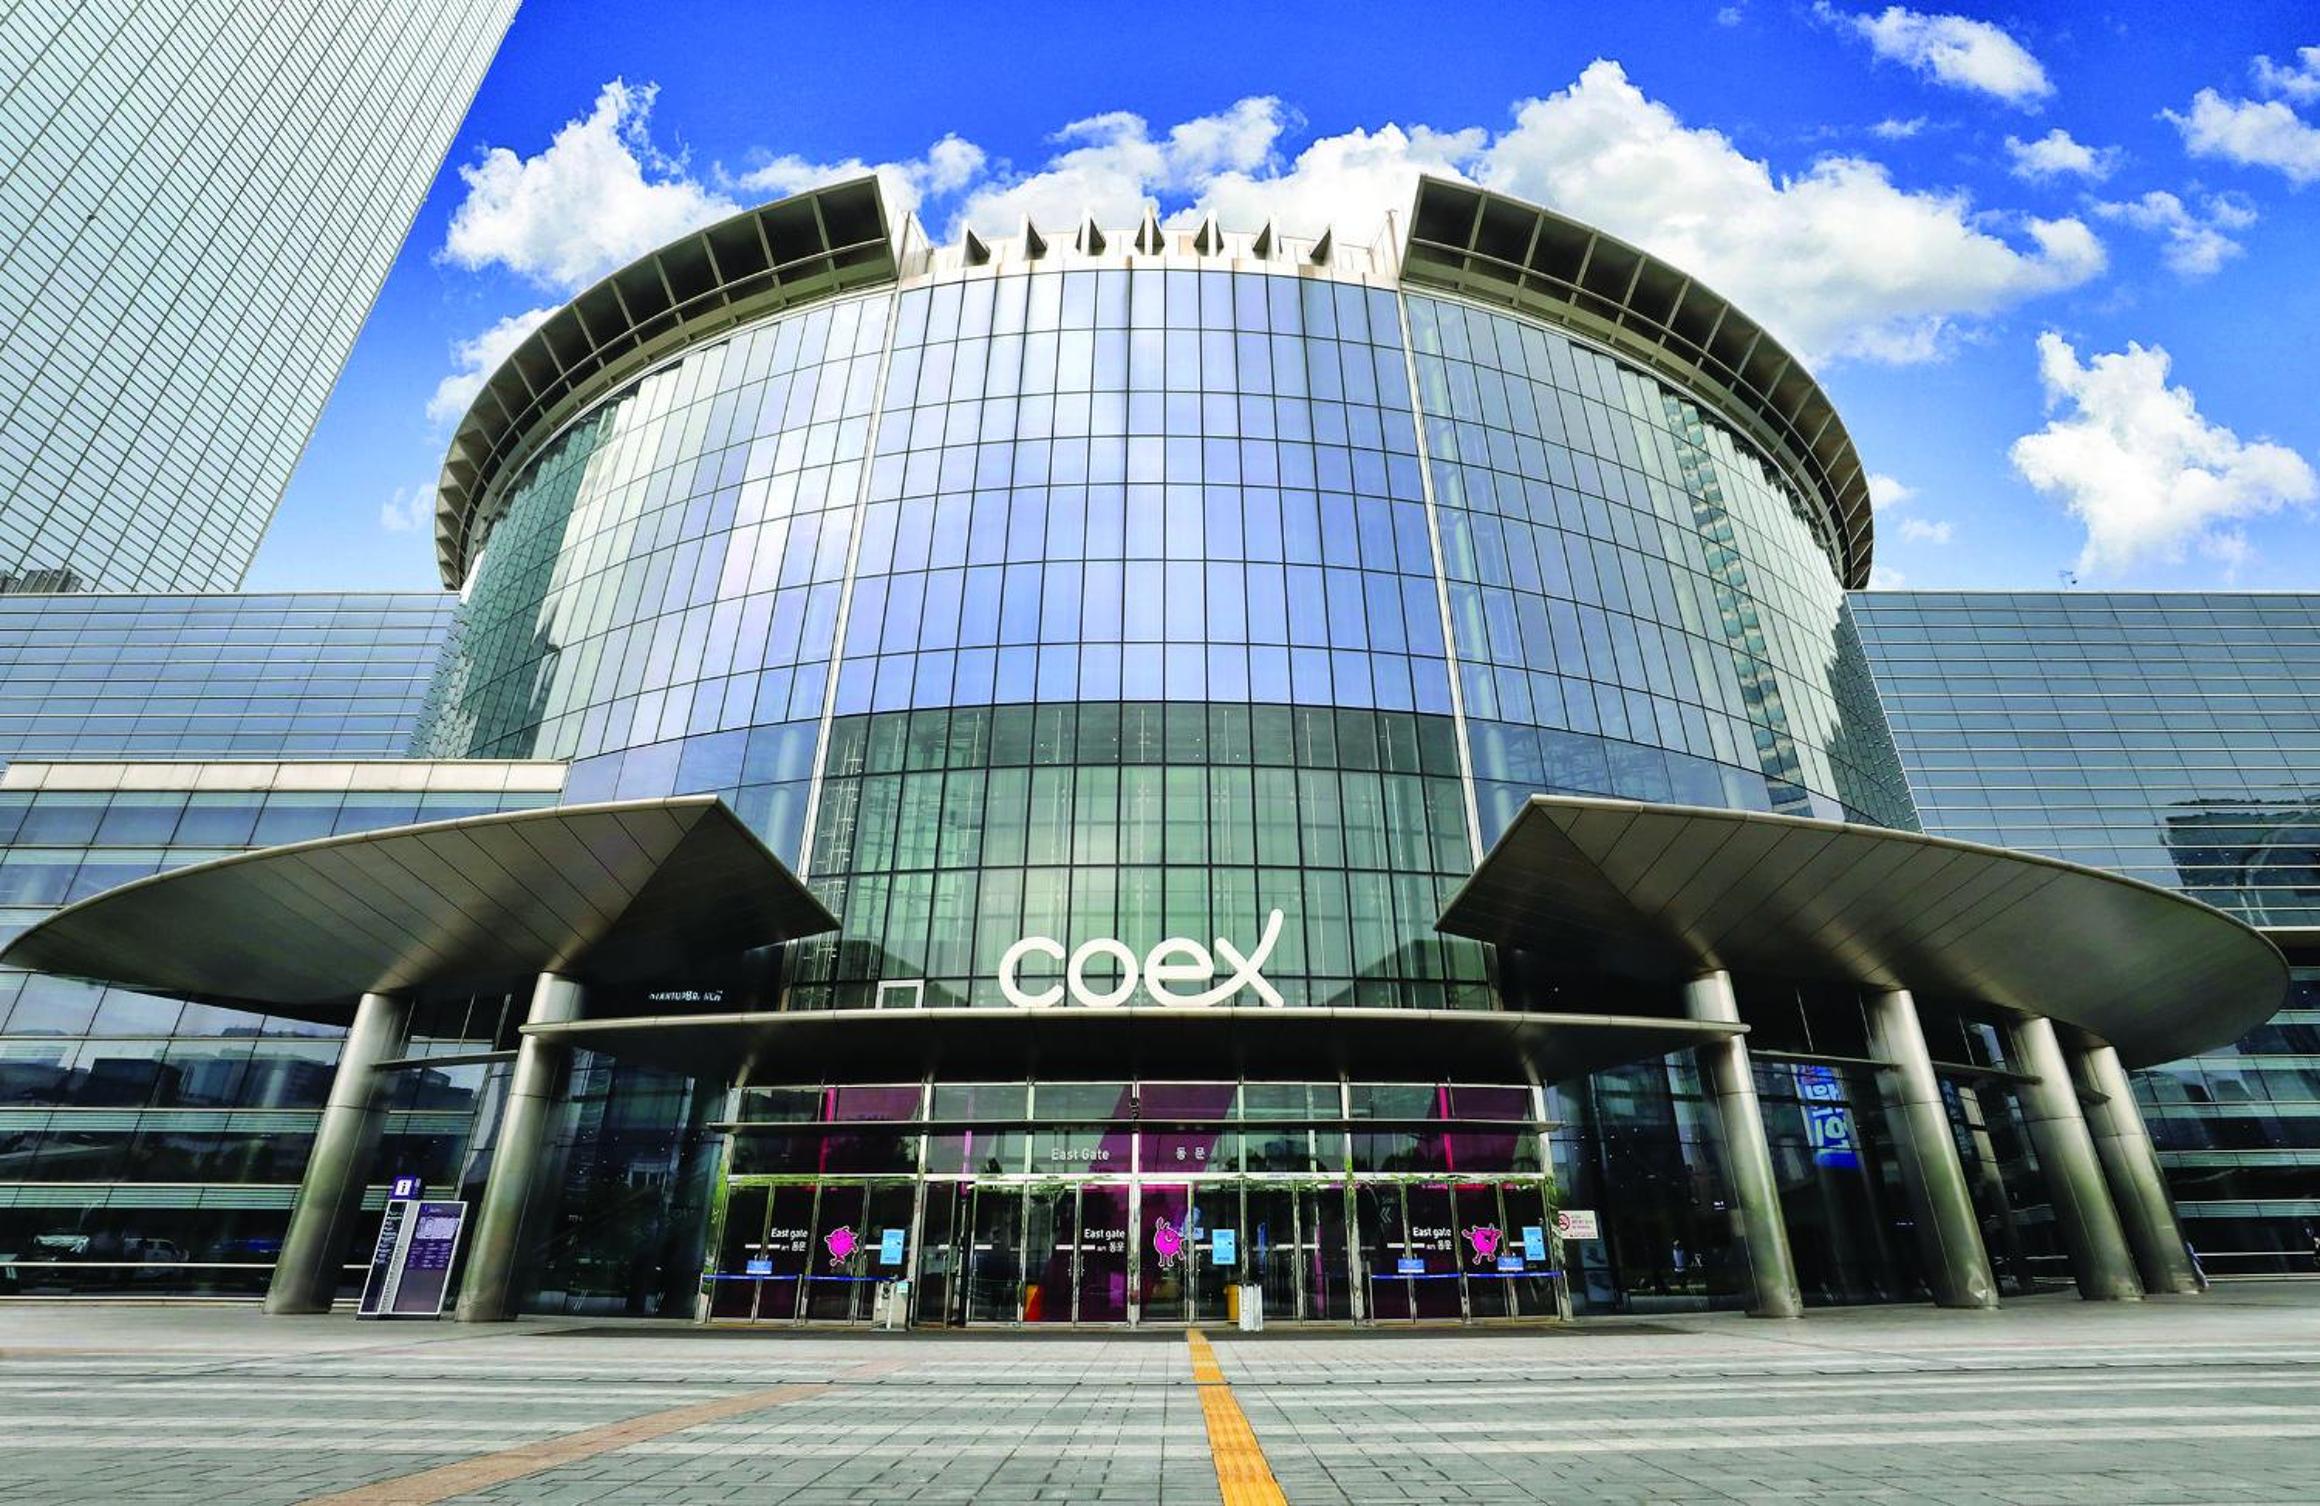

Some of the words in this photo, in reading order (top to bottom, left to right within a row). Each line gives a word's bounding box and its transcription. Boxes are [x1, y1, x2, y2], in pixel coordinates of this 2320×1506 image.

[999, 909, 1285, 1007] coex
[1051, 1148, 1078, 1161] East
[1081, 1147, 1110, 1161] Gate
[771, 1227, 789, 1238] East
[790, 1229, 808, 1240] gate
[1084, 1228, 1103, 1239] East
[1105, 1229, 1125, 1240] gate
[1413, 1227, 1432, 1237] East
[1433, 1228, 1451, 1239] gate
